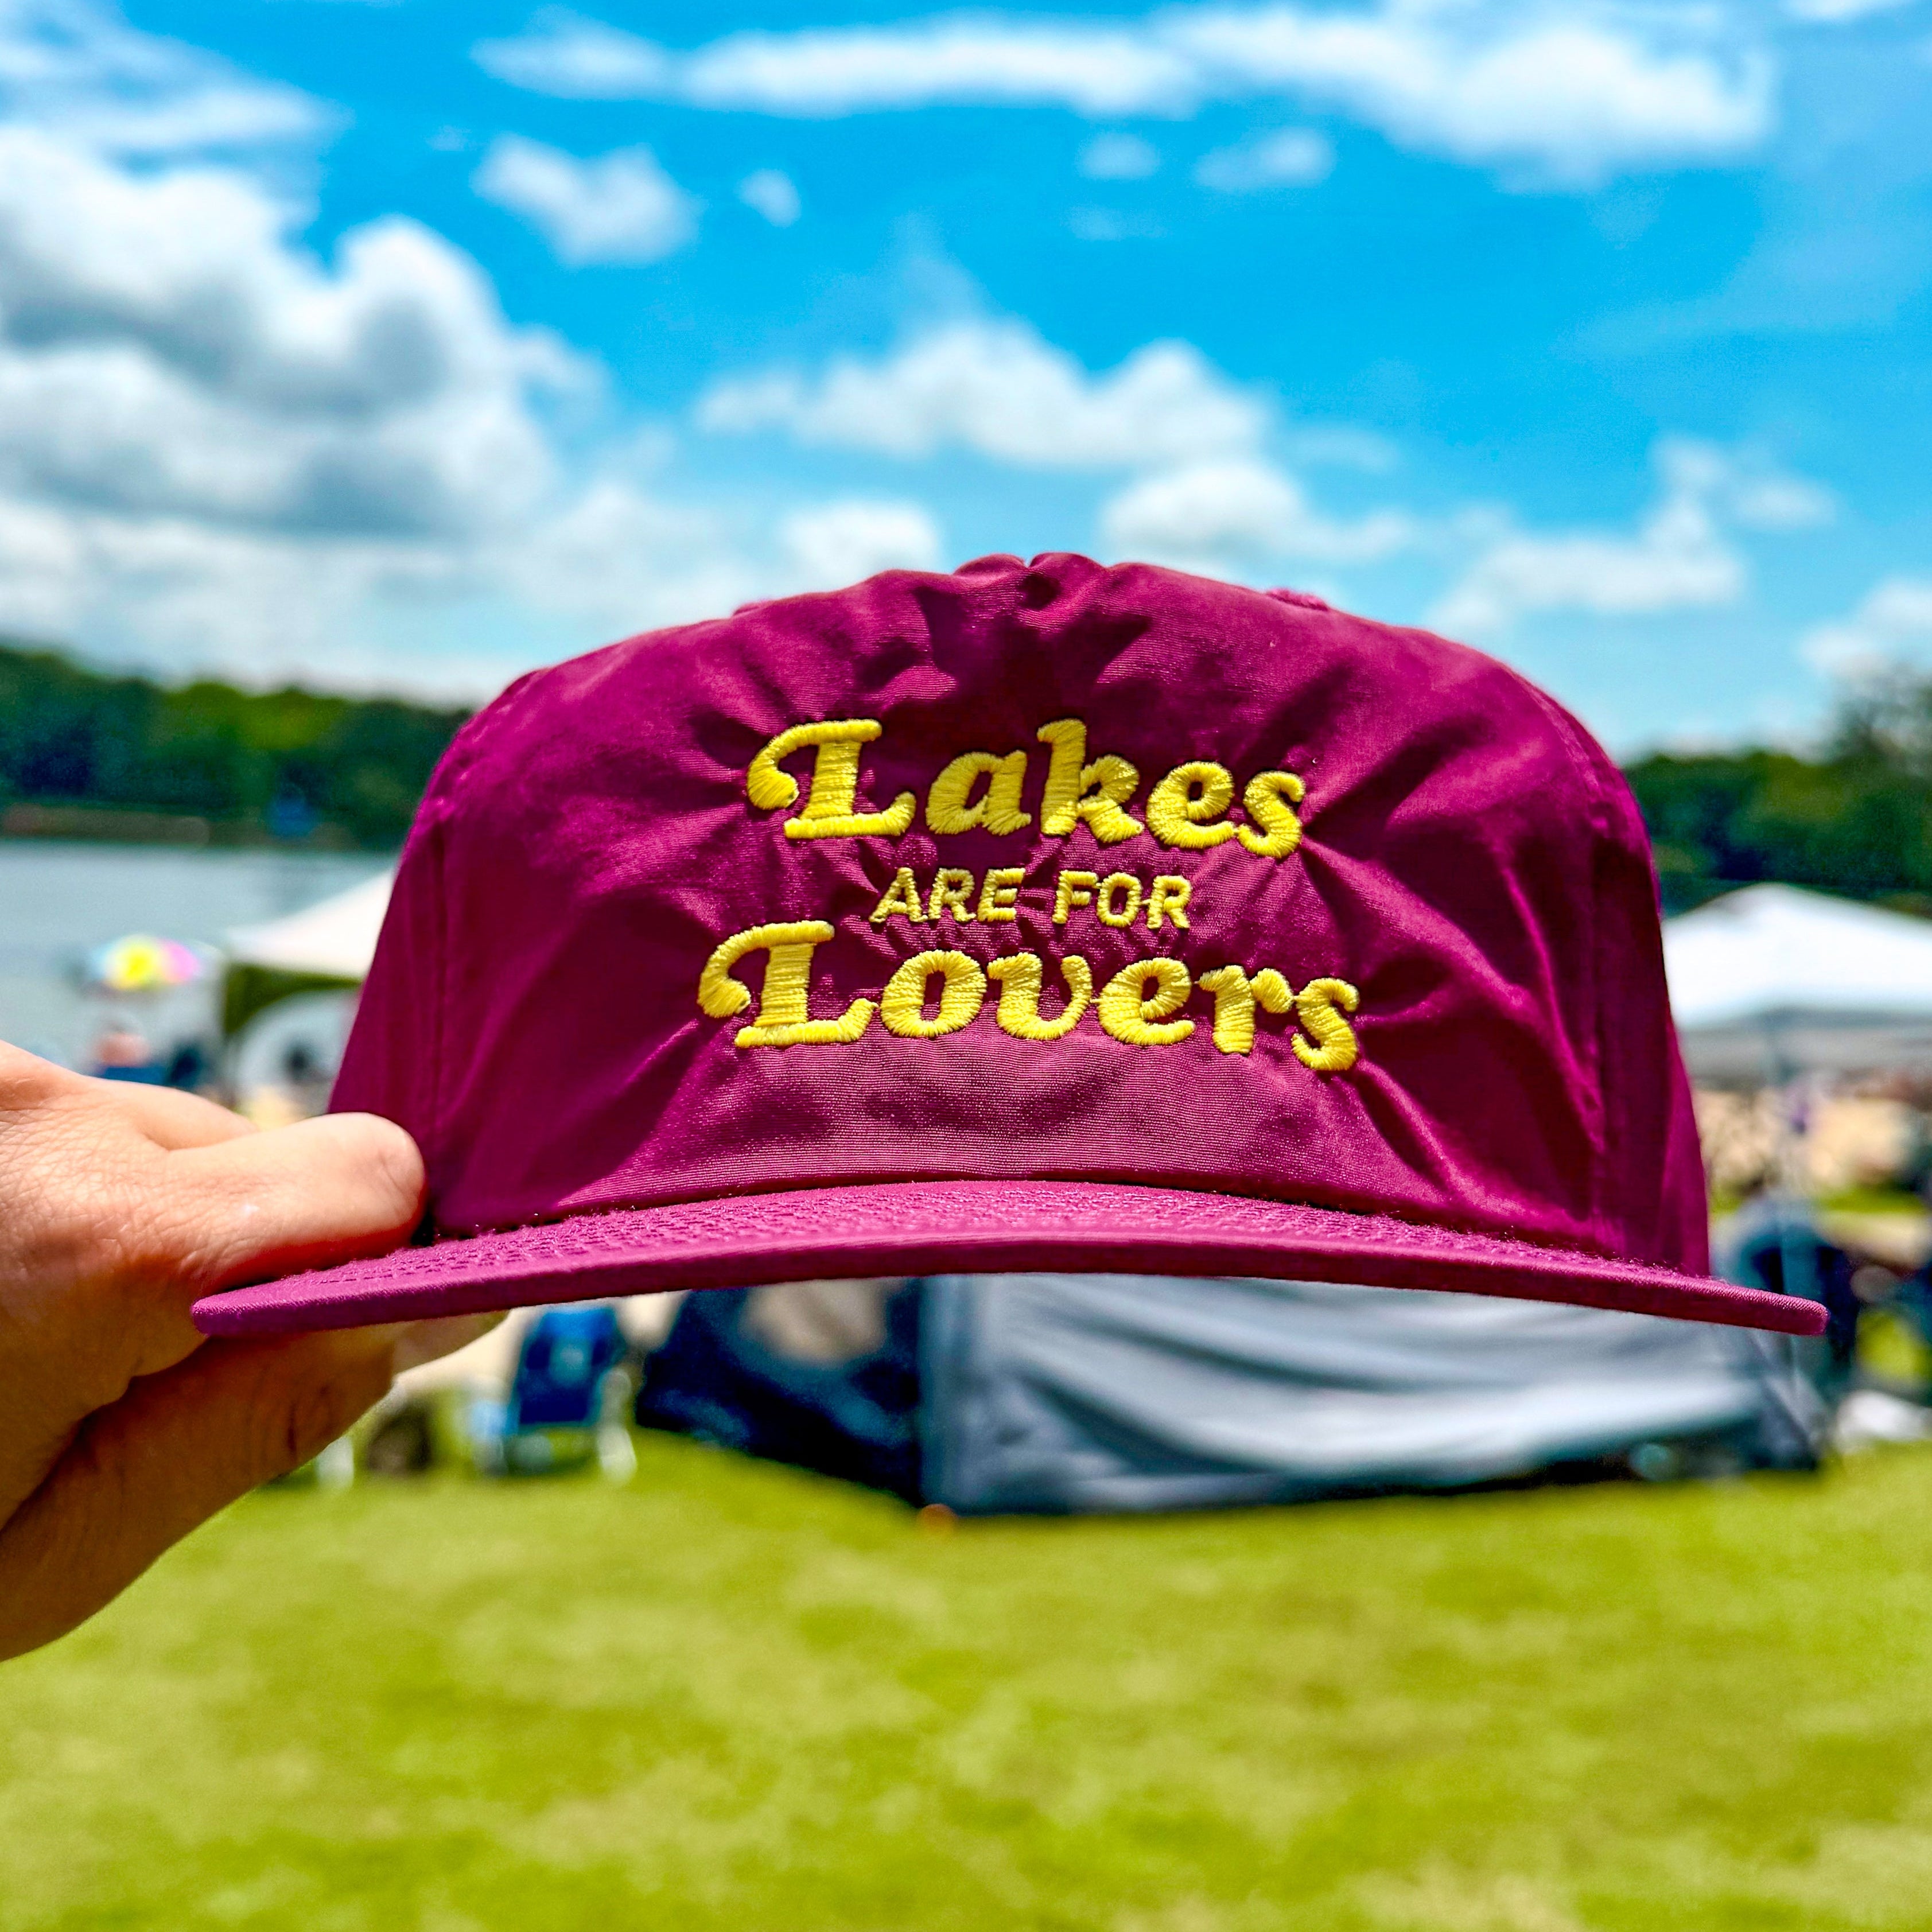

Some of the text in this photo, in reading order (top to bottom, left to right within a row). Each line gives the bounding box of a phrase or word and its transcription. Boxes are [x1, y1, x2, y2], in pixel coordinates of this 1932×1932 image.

[747, 718, 1305, 858] Lakes
[869, 867, 1191, 929] ARE FOR
[698, 920, 1359, 1071] Lovers
